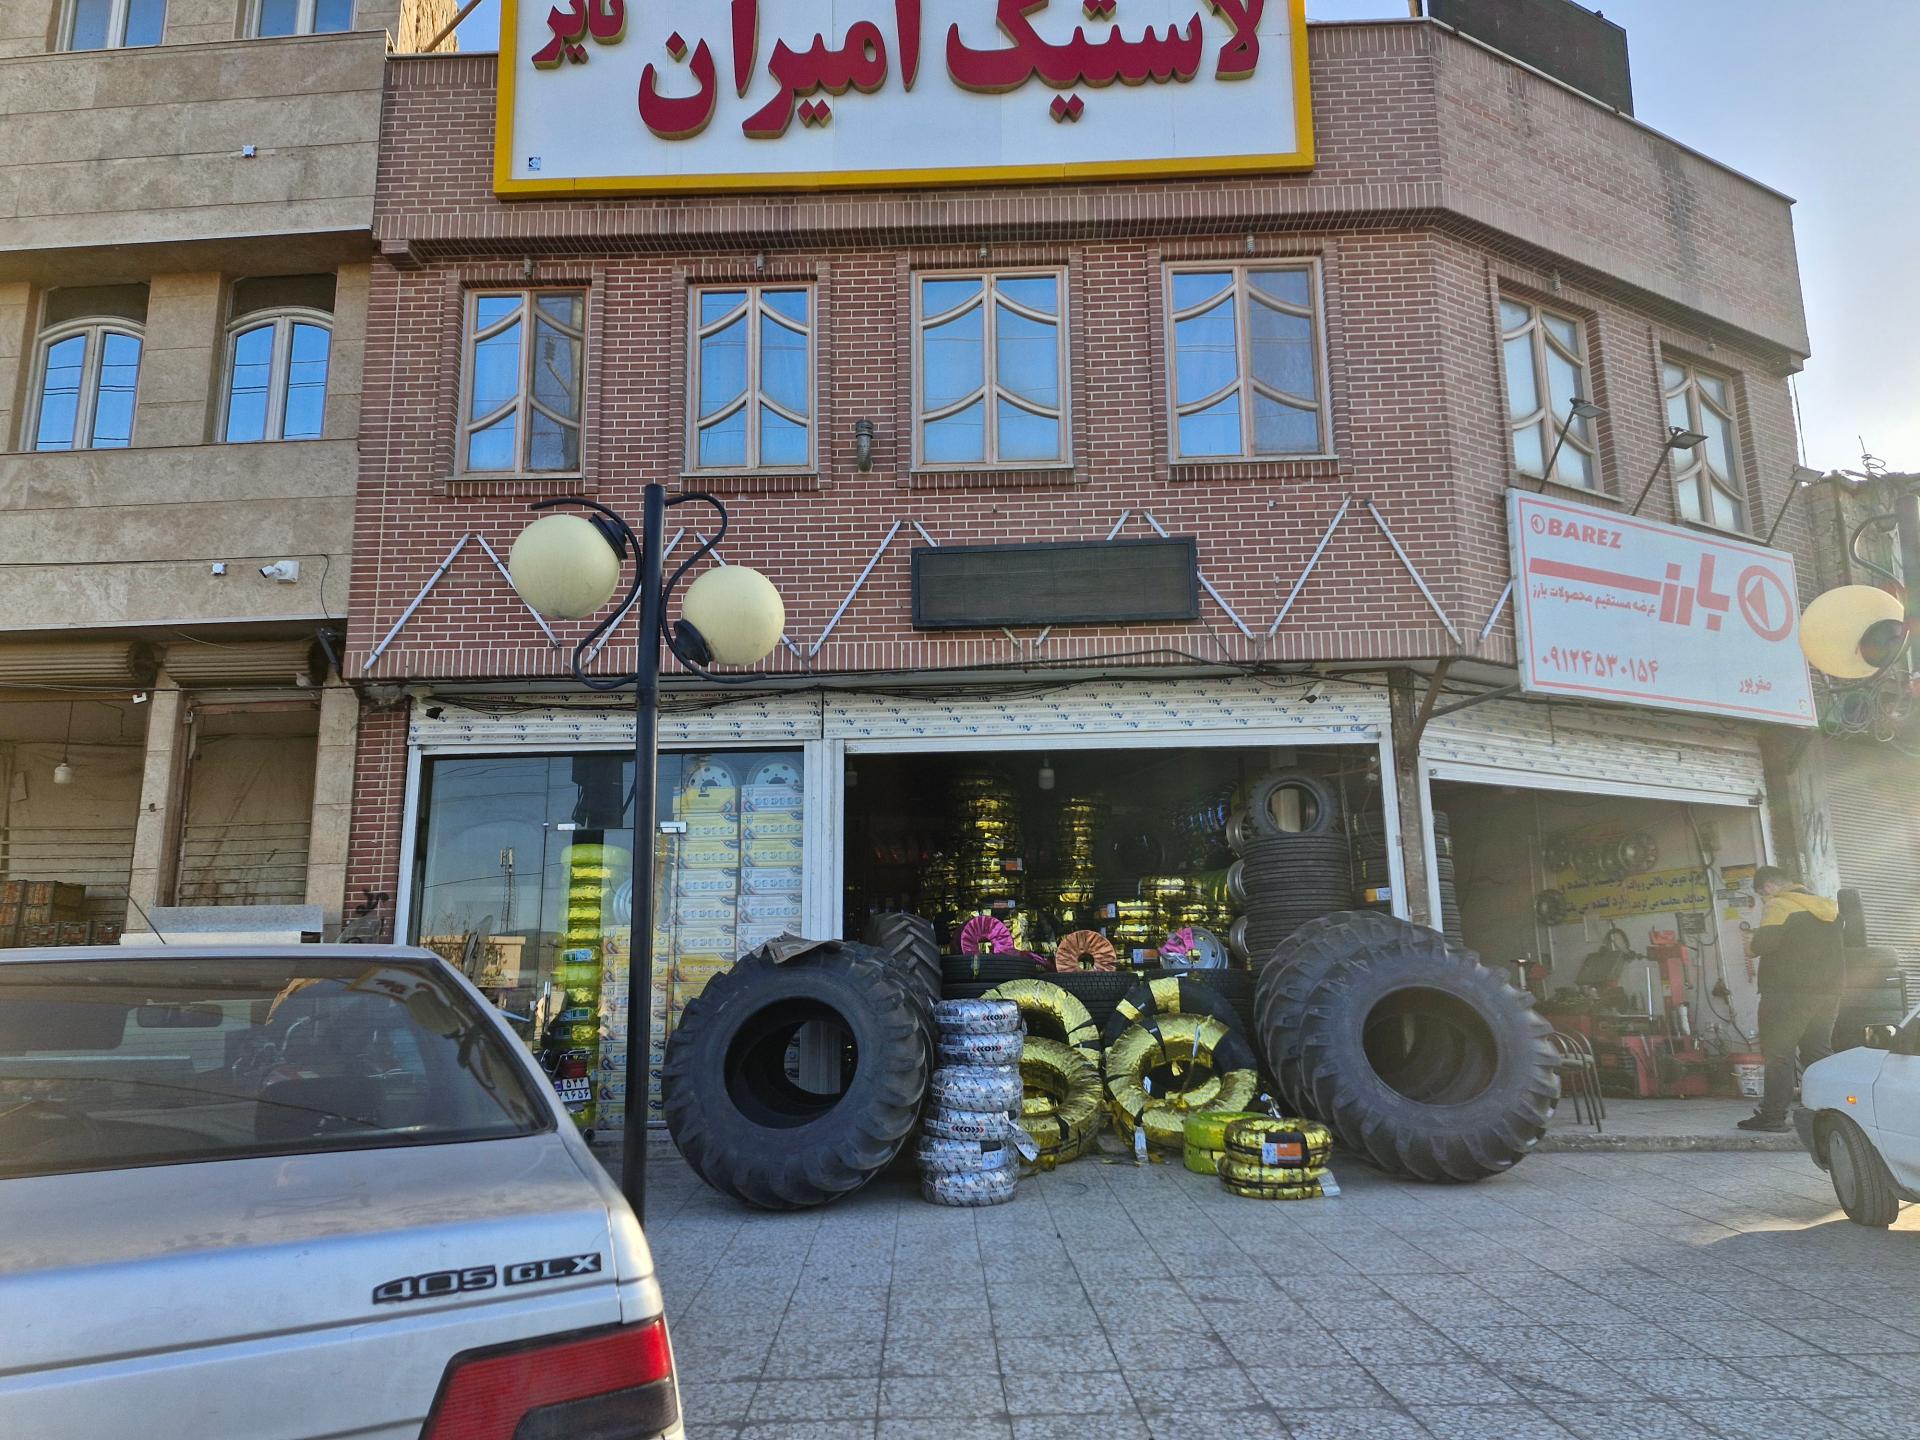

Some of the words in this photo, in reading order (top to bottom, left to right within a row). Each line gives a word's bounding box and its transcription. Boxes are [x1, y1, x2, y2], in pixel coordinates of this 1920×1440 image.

[638, 0, 922, 141] امیران
[946, 0, 1261, 123] لاستیک
[1548, 519, 1622, 548] BAREZ
[1549, 586, 1593, 603] محصولات
[1595, 592, 1631, 609] مستقیم
[1631, 600, 1656, 616] عرضه
[373, 1264, 497, 1304] 405
[503, 1252, 602, 1286] GLX
